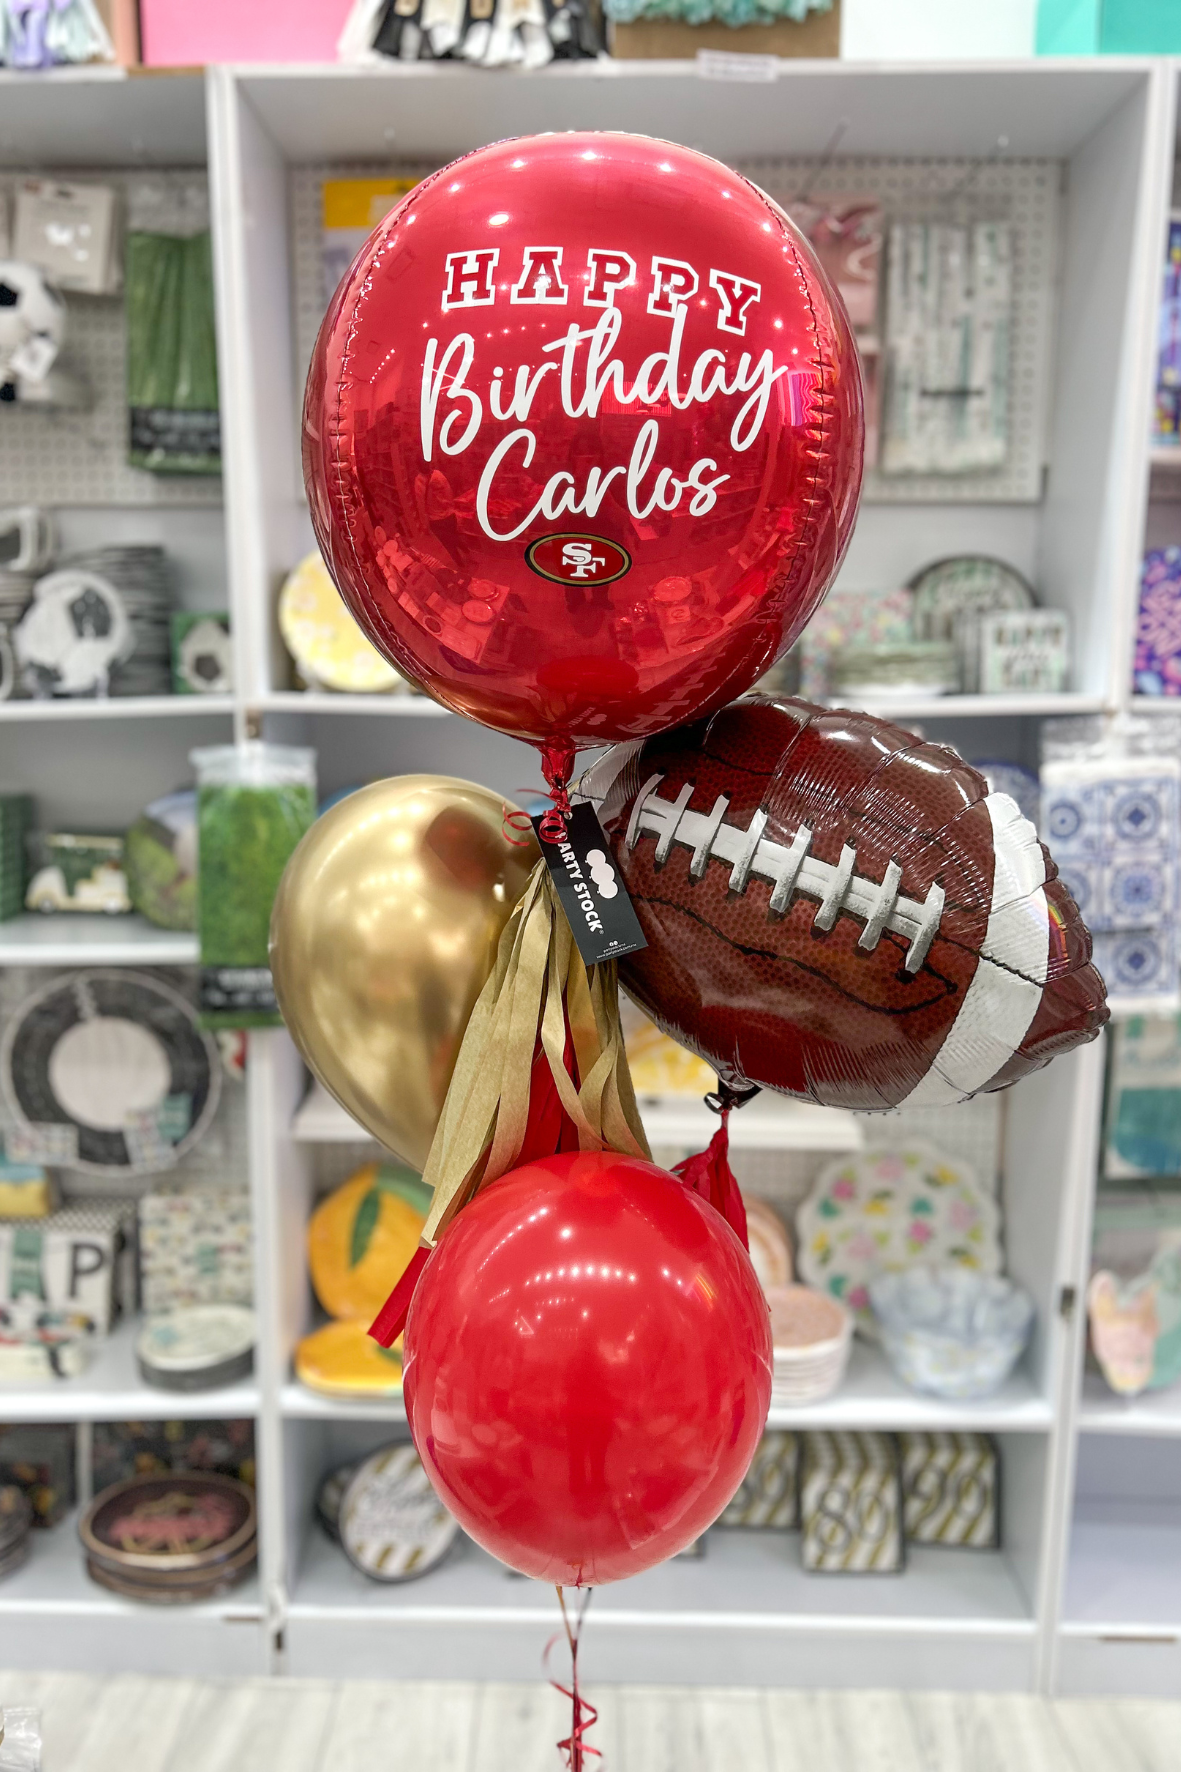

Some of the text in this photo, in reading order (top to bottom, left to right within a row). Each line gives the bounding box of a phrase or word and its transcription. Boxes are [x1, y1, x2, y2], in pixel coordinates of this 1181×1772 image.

[441, 246, 762, 336] HAPPY
[420, 304, 788, 462] Birthday
[476, 419, 731, 541] Carlos
[562, 543, 606, 578] SF
[816, 1481, 888, 1555] 80
[905, 1462, 988, 1527] 90
